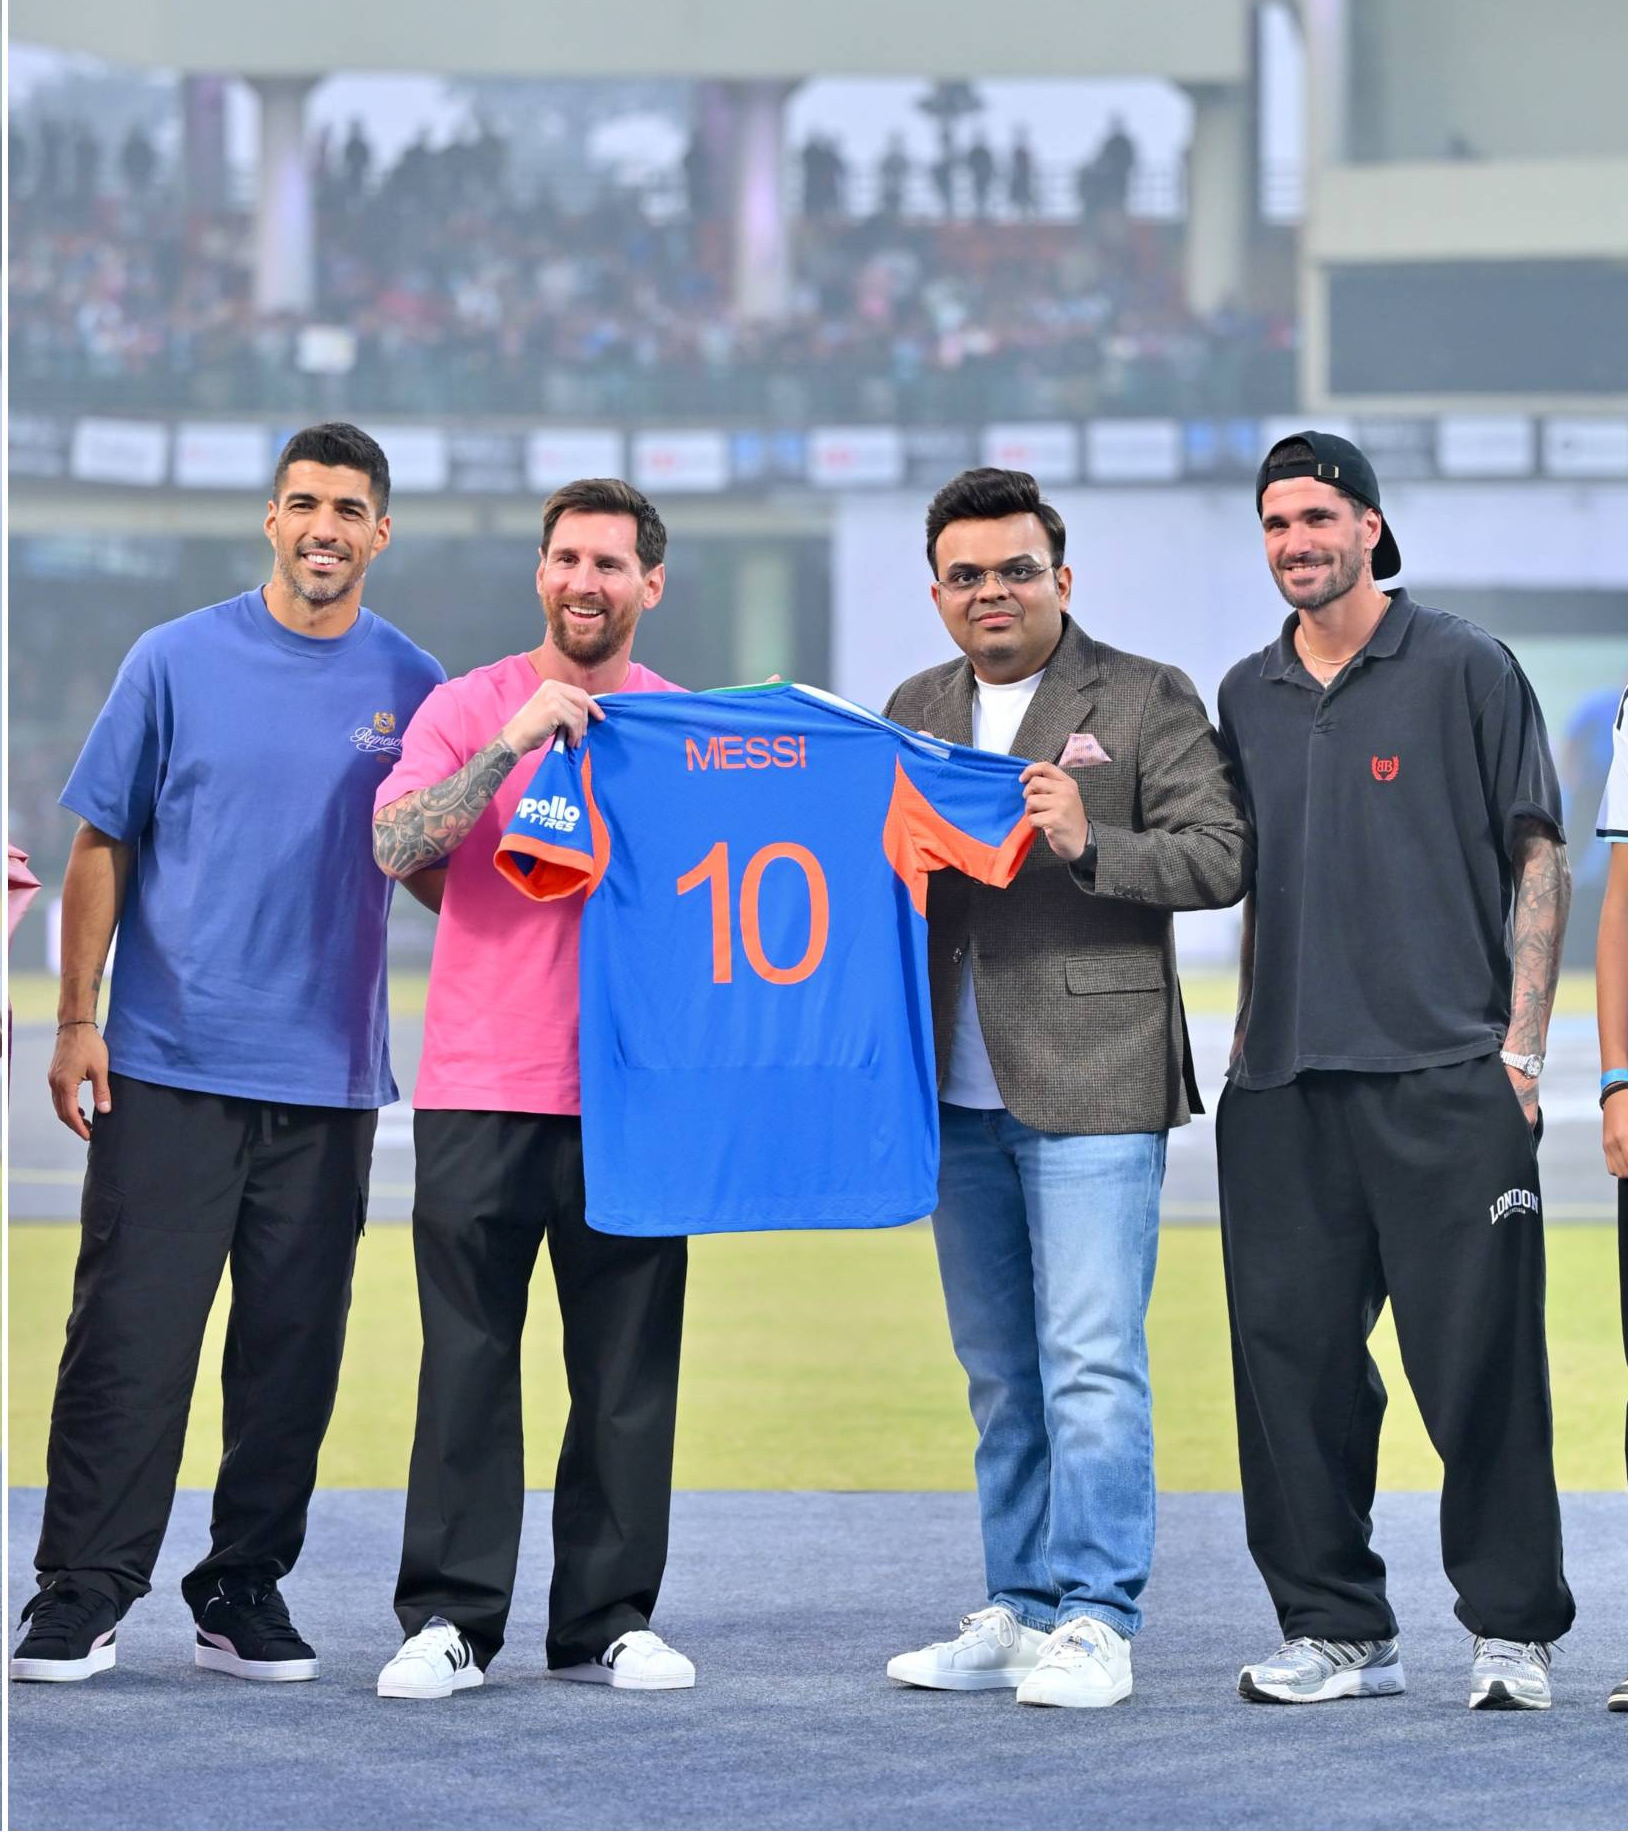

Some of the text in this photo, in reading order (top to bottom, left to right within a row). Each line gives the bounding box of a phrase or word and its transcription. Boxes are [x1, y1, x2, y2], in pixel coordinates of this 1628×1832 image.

[685, 735, 806, 771] MESSI
[516, 795, 580, 822] pollo
[529, 813, 576, 832] TYRES
[676, 842, 829, 985] 10
[1489, 1188, 1539, 1225] LONDON
